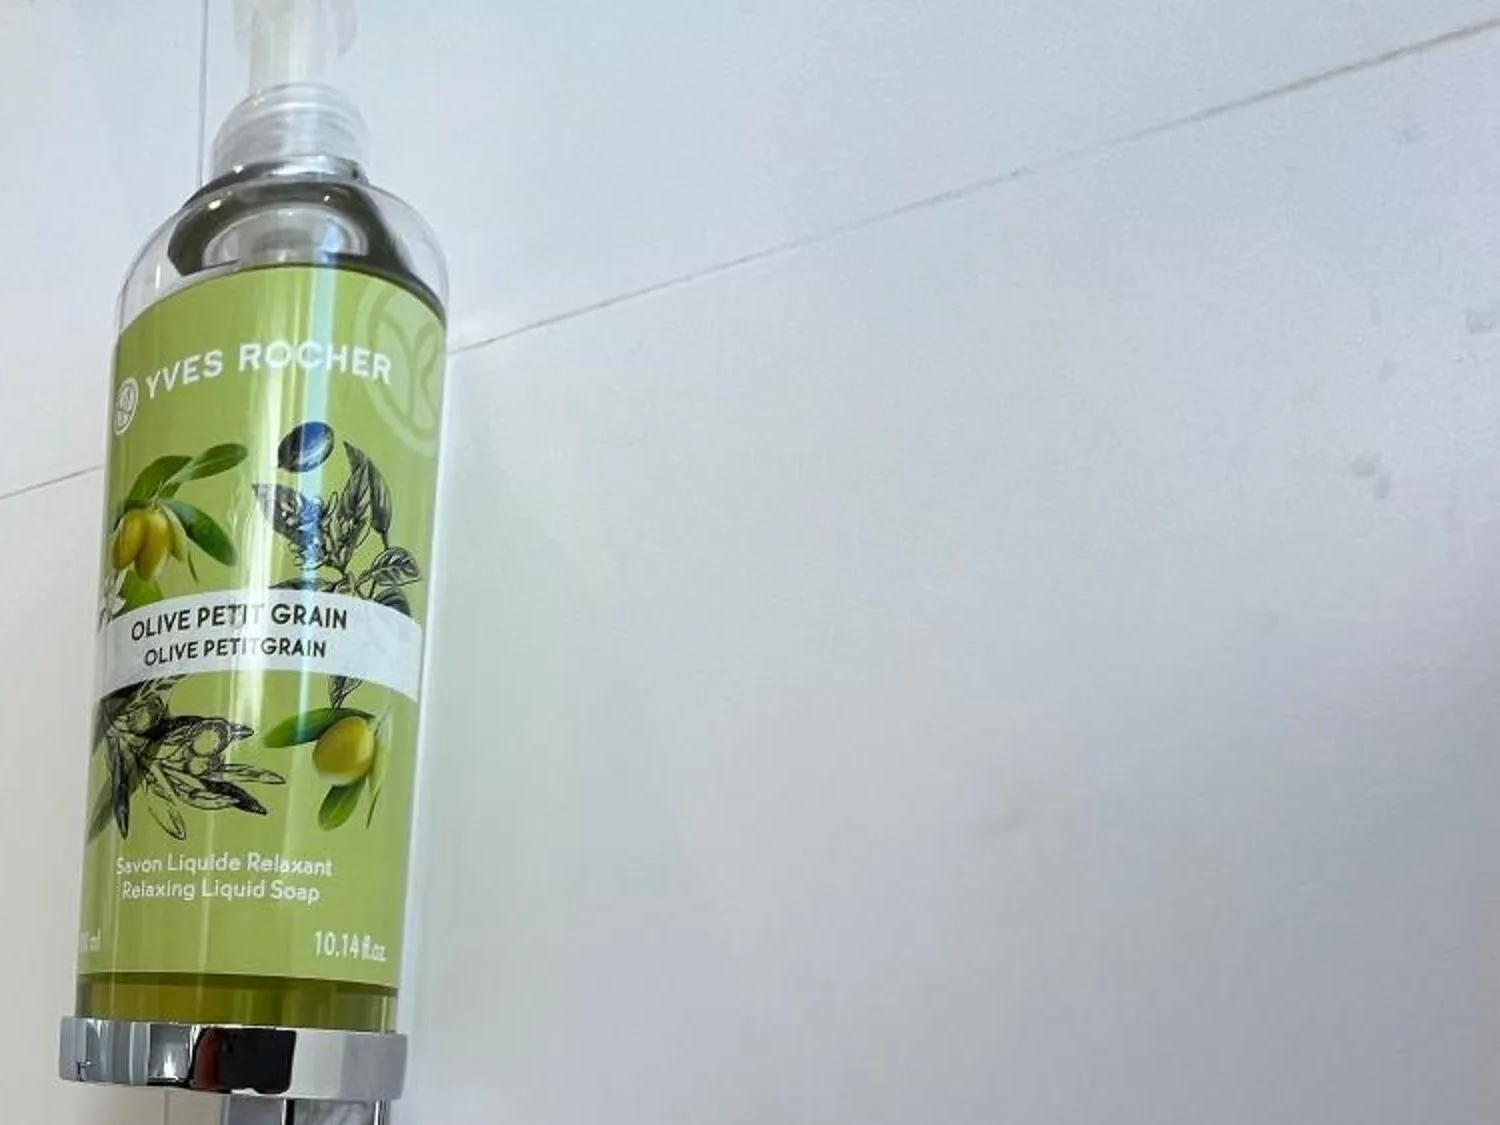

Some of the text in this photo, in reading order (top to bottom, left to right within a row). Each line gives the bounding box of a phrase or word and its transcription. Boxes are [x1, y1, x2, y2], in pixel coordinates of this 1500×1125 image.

[146, 340, 392, 398] YVES ROCHER
[131, 603, 347, 641] OLIVE PETIT GRAIN
[144, 637, 327, 666] OLIVE PETIT GRAIN
[116, 852, 333, 876] Savon Liquide Relaxant
[122, 878, 320, 904] Relaxing Liquid Soap
[315, 931, 359, 959] 10.14
